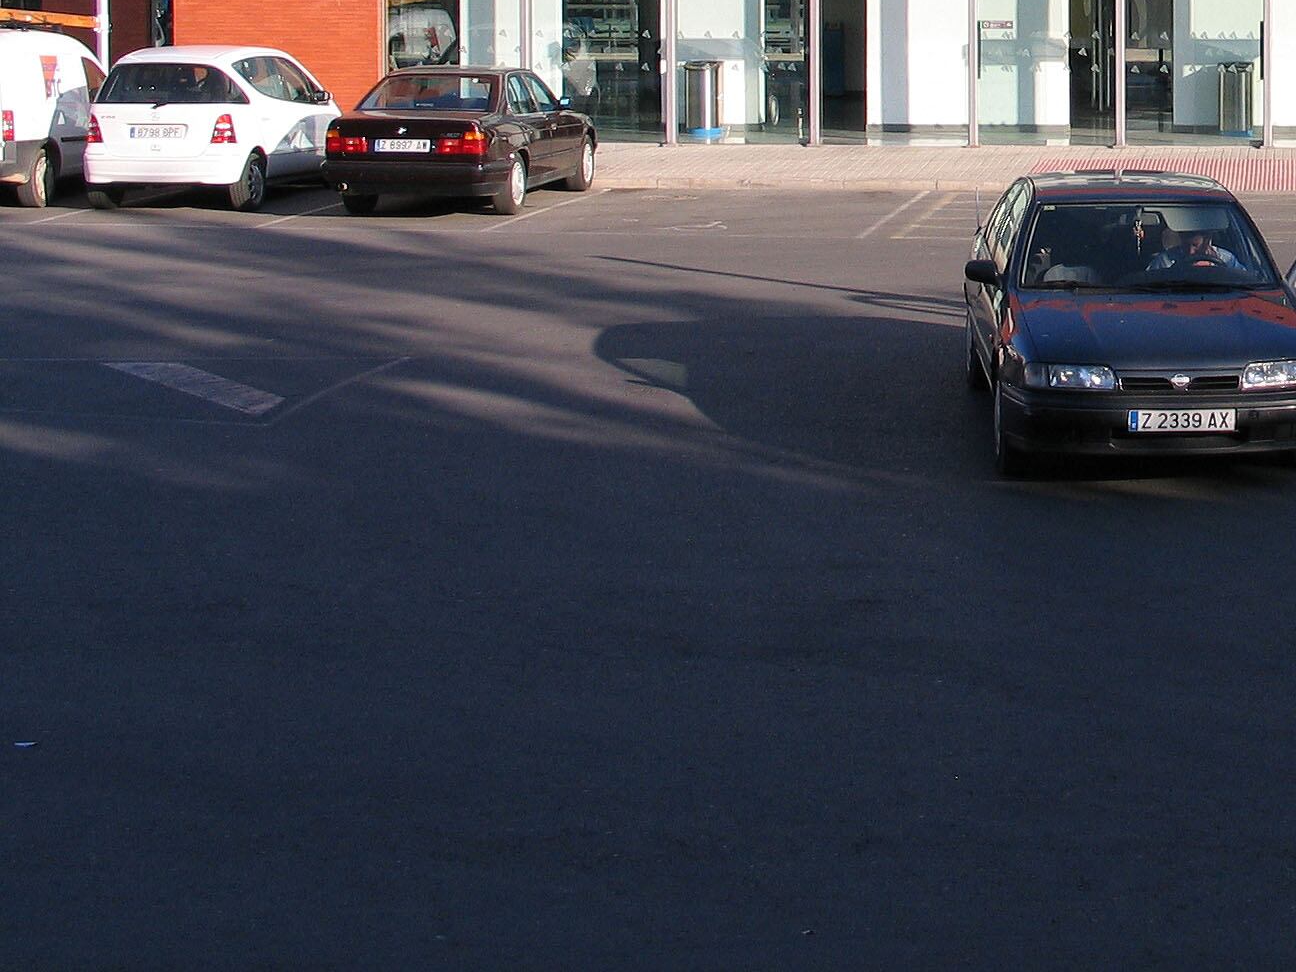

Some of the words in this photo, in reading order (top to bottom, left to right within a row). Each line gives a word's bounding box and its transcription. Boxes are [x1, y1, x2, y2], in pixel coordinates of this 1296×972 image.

[1141, 412, 1152, 429] Z
[1157, 412, 1202, 429] 2339
[1207, 412, 1229, 429] AX
